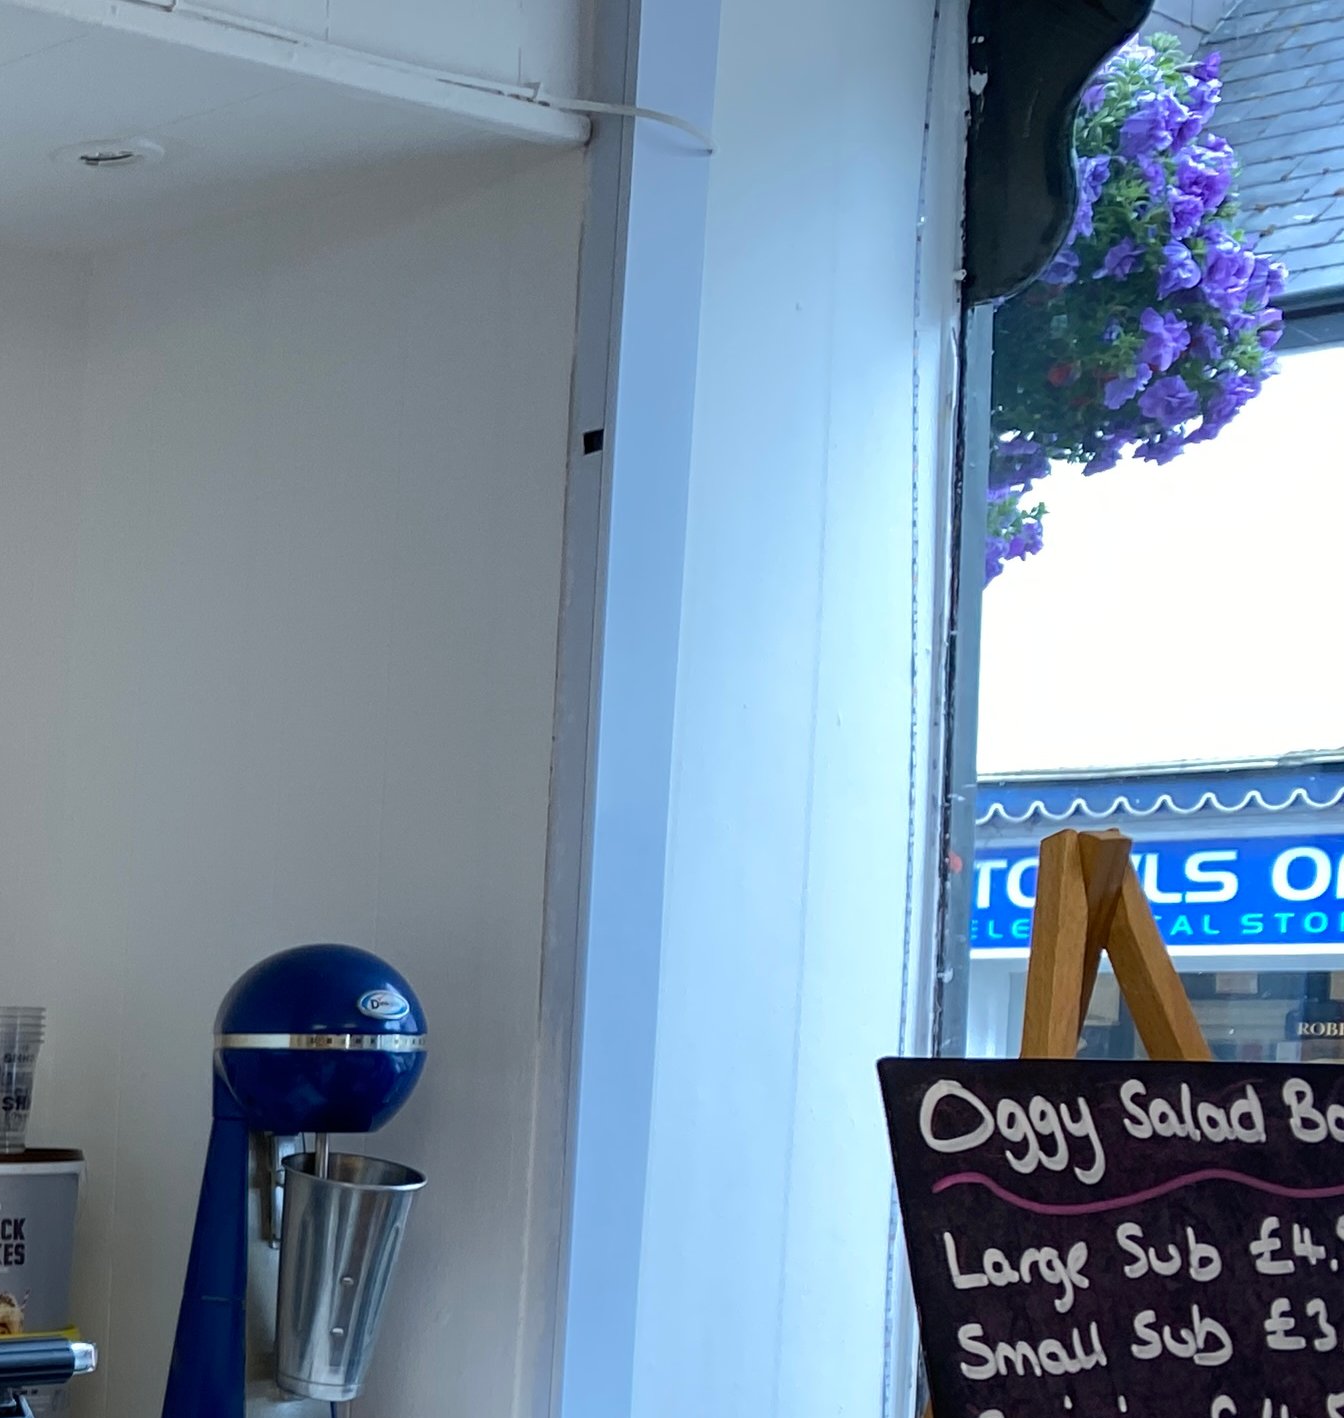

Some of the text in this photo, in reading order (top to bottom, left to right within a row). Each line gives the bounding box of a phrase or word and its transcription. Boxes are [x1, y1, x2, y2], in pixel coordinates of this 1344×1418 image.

[1240, 911, 1344, 936] STO
[919, 1078, 1107, 1184] Oggy
[1120, 1079, 1267, 1143] Salad
[943, 1231, 1090, 1312] Large
[1116, 1221, 1223, 1282] Sub
[957, 1320, 1108, 1380] Small
[1130, 1303, 1234, 1367] Sub
